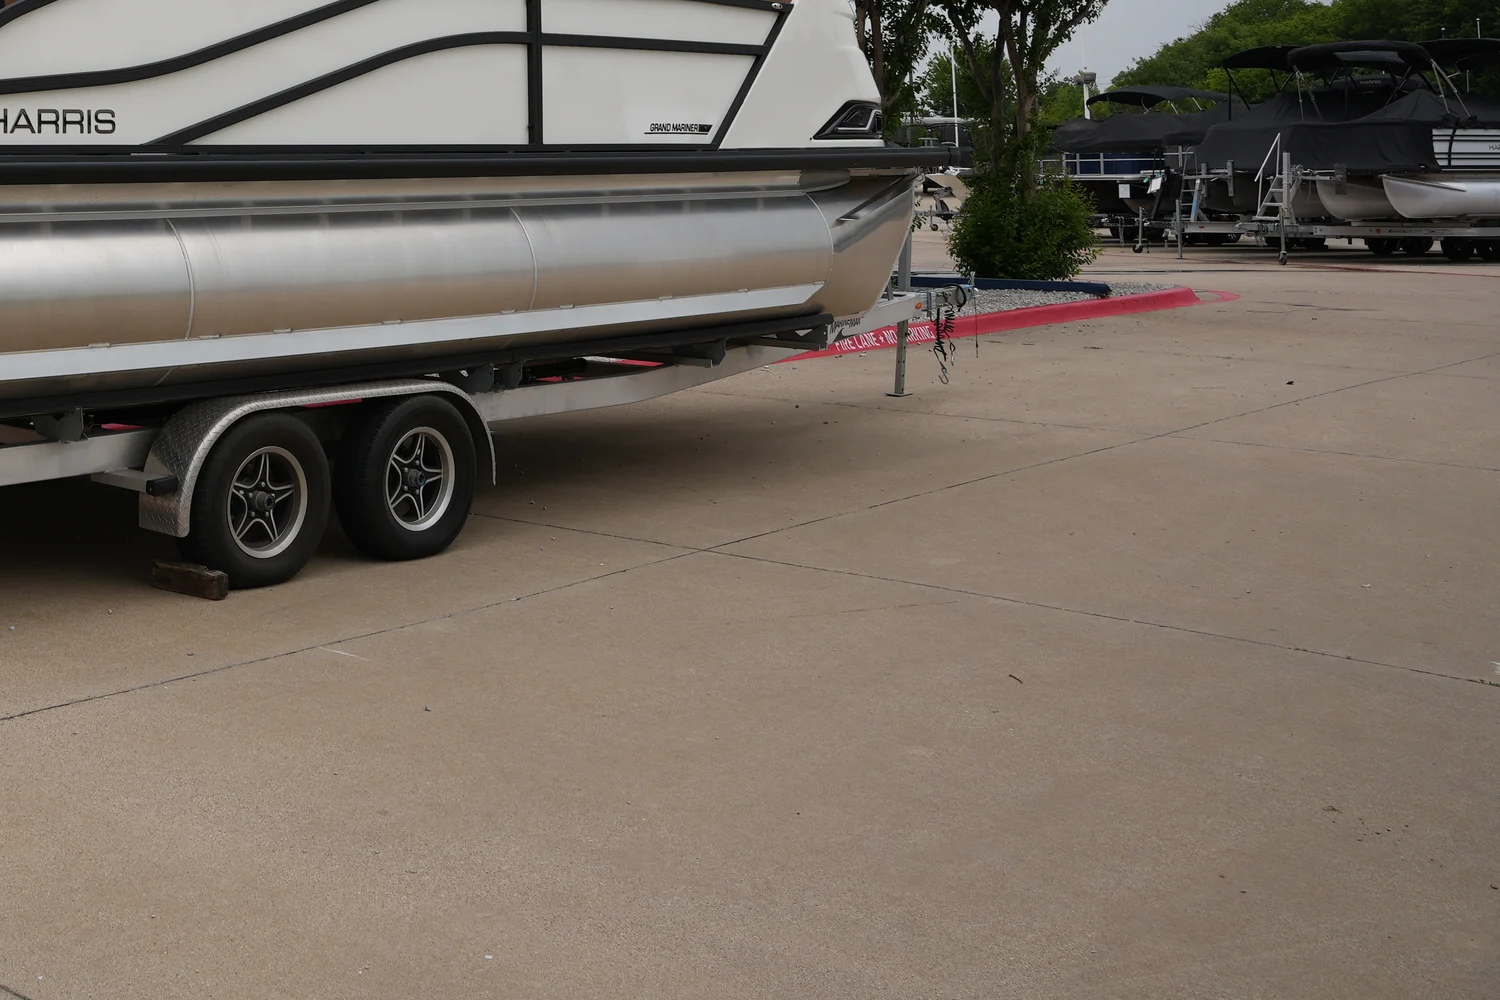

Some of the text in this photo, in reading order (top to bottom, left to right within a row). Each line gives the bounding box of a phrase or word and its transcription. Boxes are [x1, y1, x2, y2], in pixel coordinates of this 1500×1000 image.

[649, 122, 699, 132] GRAND MARINER
[834, 338, 857, 352] FIRE
[853, 331, 881, 349] LANE
